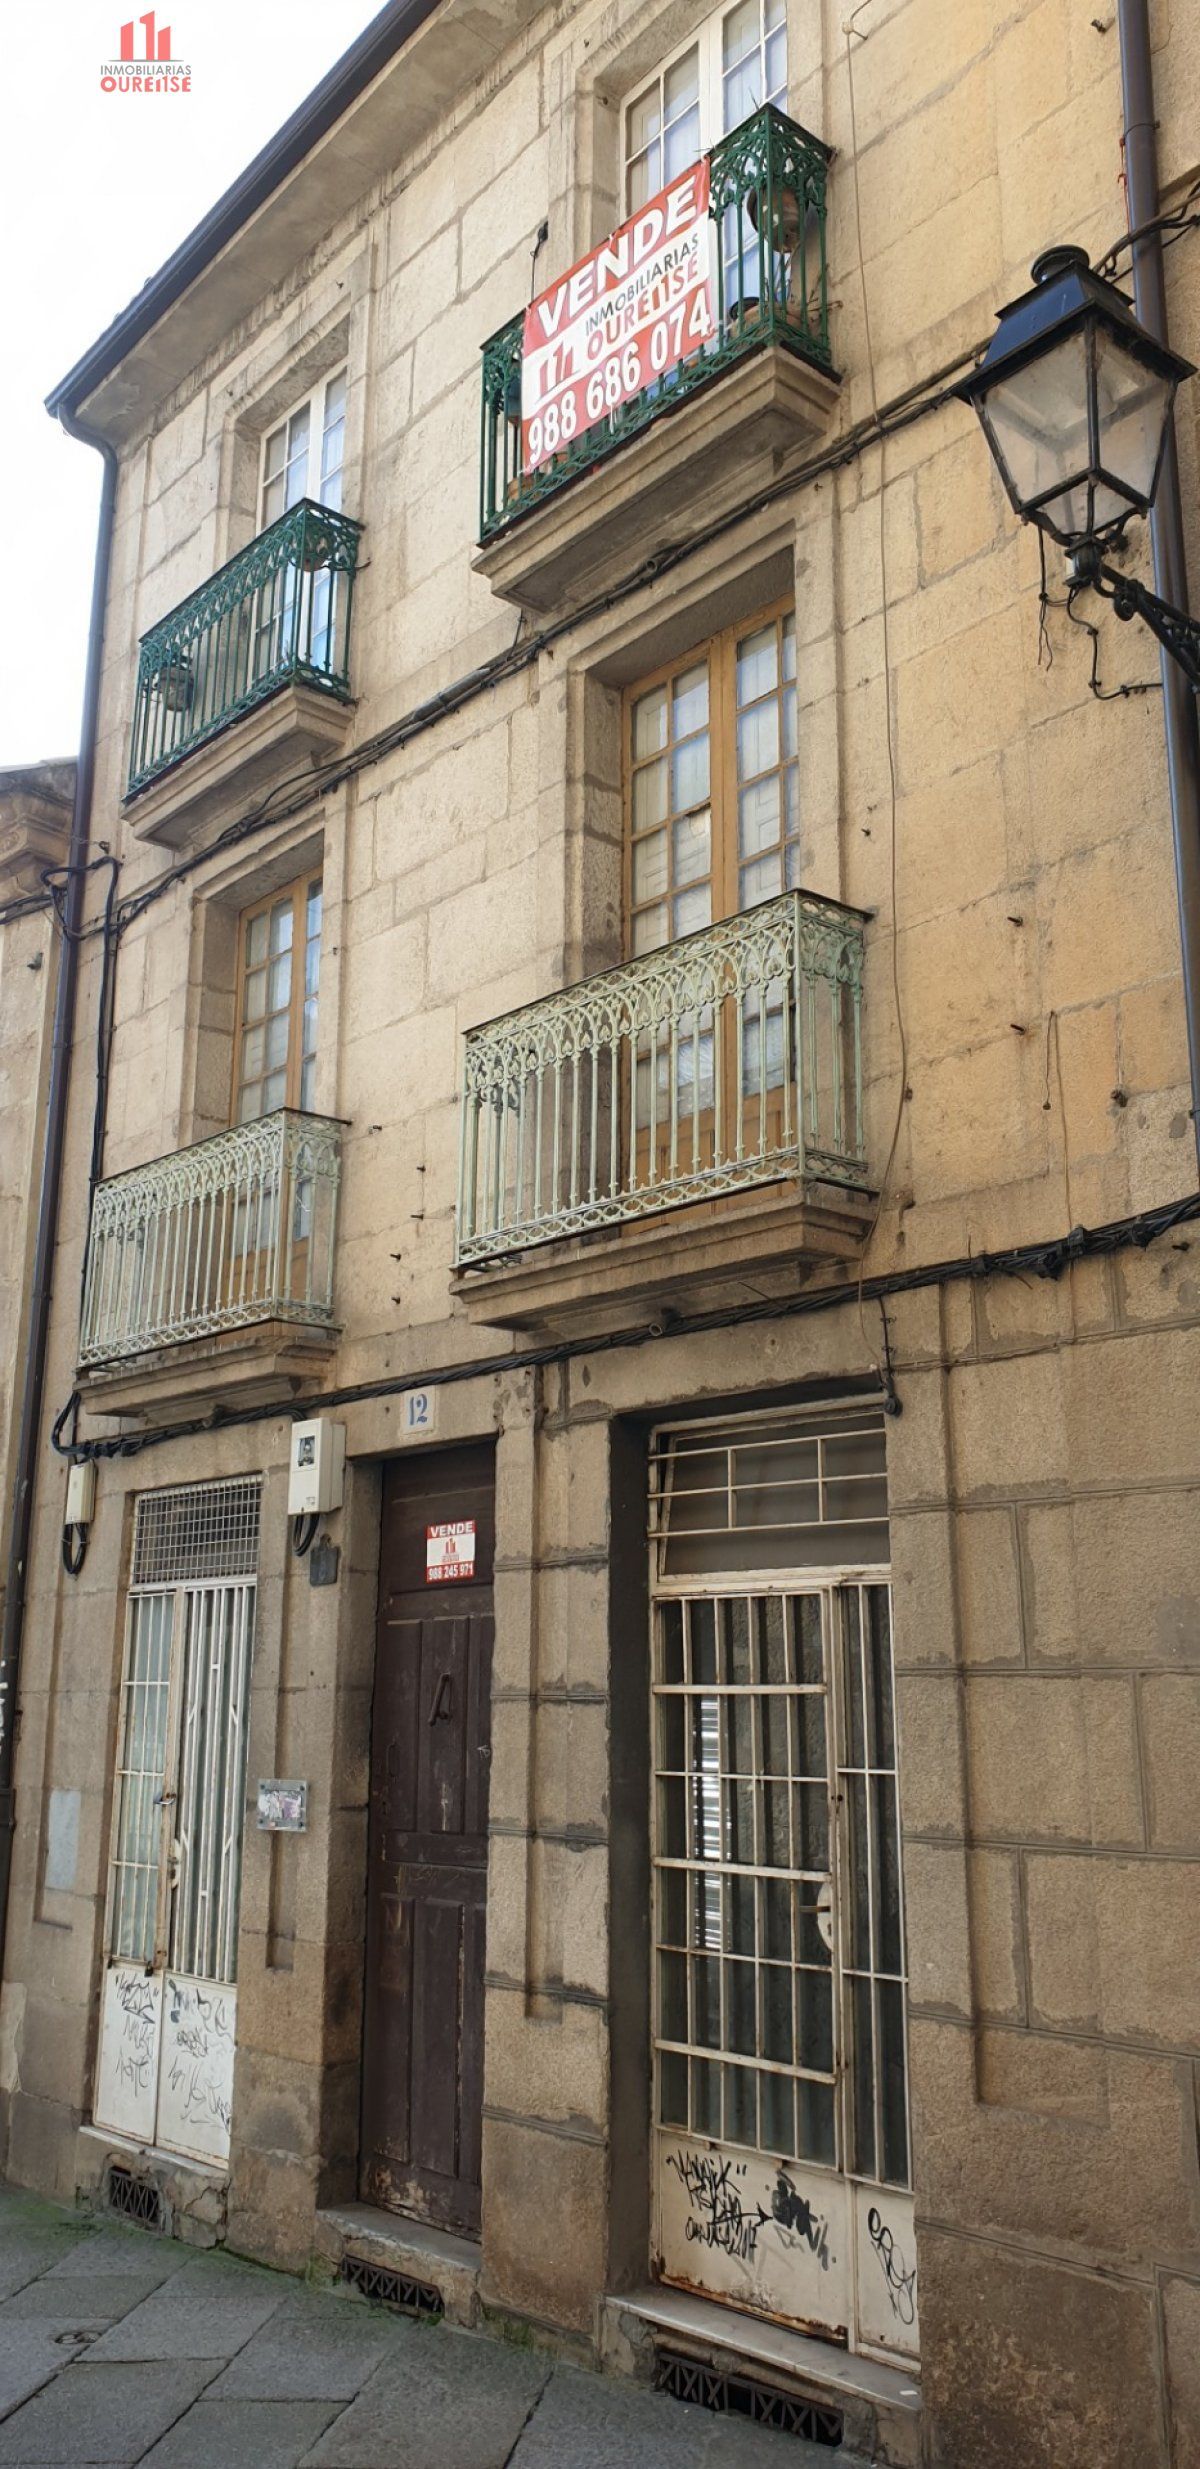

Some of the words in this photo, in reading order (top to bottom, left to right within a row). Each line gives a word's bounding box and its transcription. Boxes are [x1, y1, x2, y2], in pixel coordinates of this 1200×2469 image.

[536, 174, 698, 338] VENDE
[585, 232, 699, 337] INMOBILIARIAS
[587, 250, 699, 361] OURENSE
[527, 389, 577, 465] 988
[585, 341, 641, 420] 686
[649, 286, 712, 371] 074
[408, 1393, 429, 1426] 12
[430, 1520, 474, 1538] VENDE
[444, 1564, 459, 1578] 245
[459, 1562, 474, 1577] 971
